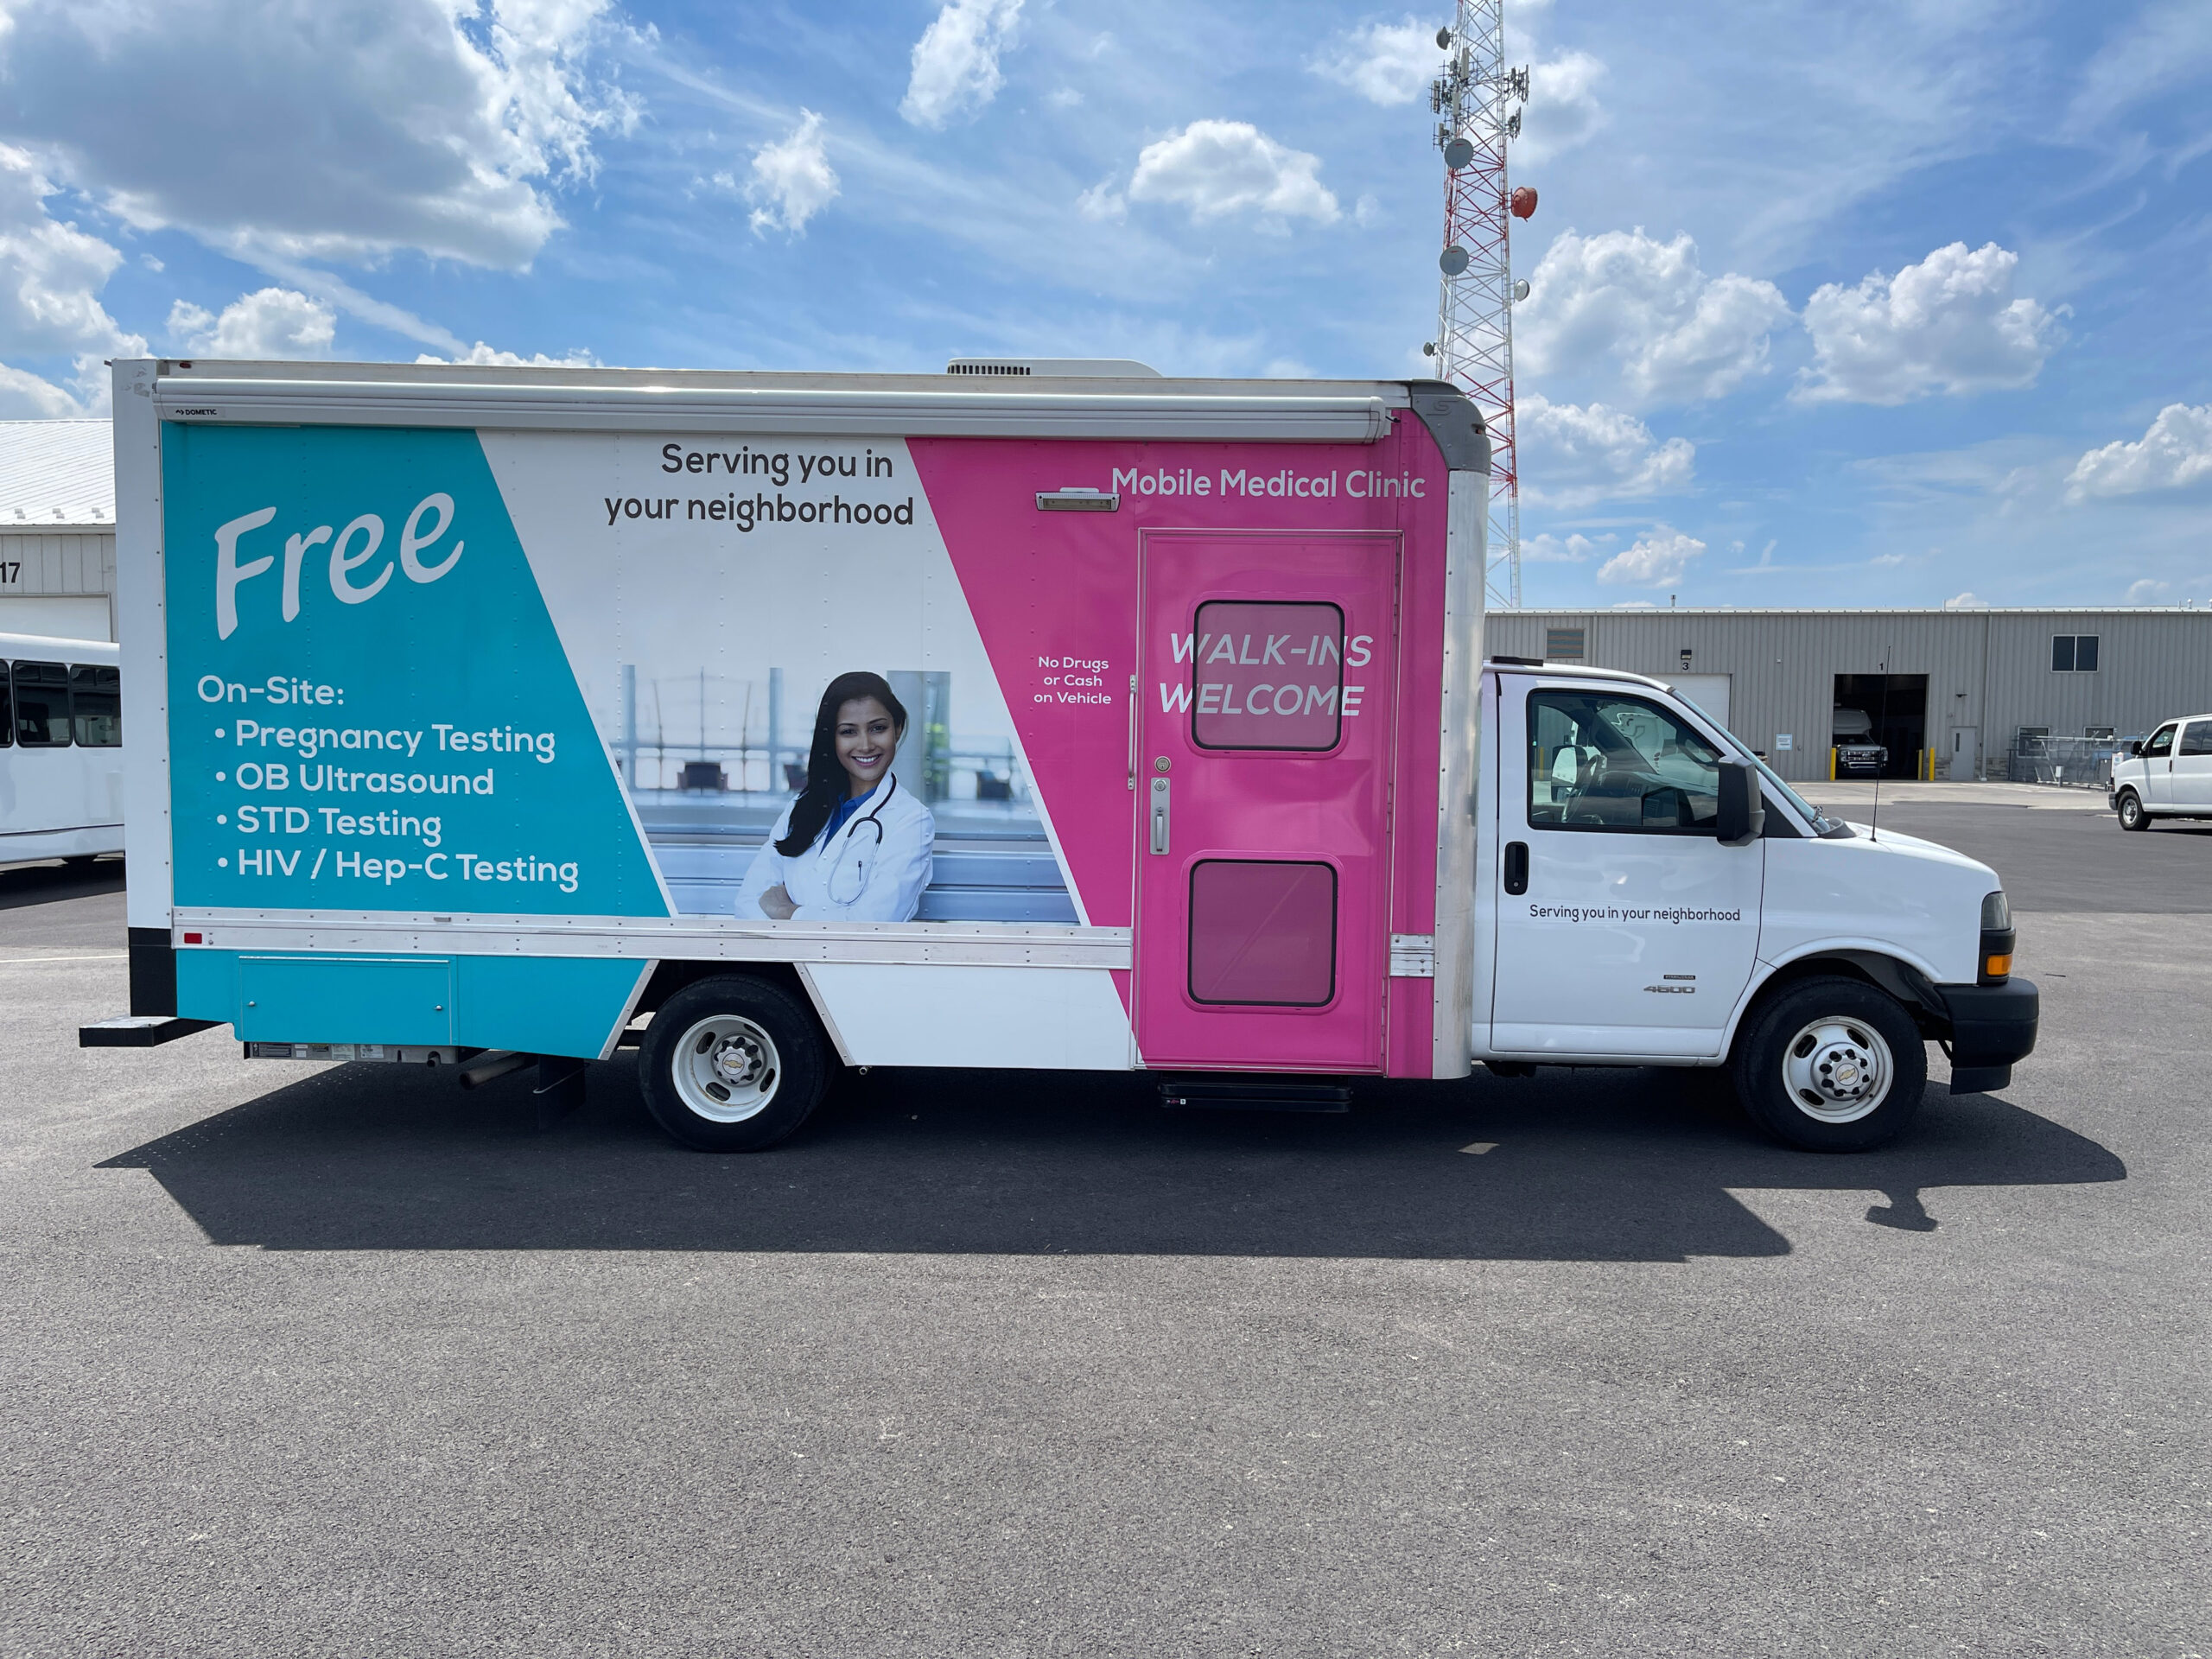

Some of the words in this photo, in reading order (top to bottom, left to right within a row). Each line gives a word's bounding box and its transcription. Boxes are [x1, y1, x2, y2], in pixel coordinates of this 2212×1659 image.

[661, 443, 790, 487] Serving
[797, 454, 856, 484] you
[866, 448, 893, 478] in
[1111, 467, 1212, 498] Mobile
[1220, 469, 1338, 499] Medical
[1345, 469, 1426, 499] Clinic
[604, 497, 680, 526] your
[688, 492, 913, 533] neighborhood
[214, 492, 465, 641] Free
[1038, 656, 1059, 669] No
[1062, 656, 1109, 673] Drugs
[1170, 633, 1374, 666] WALK-INS
[1043, 676, 1061, 687] or
[1064, 674, 1103, 687] Cash
[1682, 662, 1689, 671] 3
[1879, 662, 1884, 671] 1
[197, 674, 344, 707] On-Site:
[1033, 693, 1052, 704] on
[1056, 690, 1112, 705] Vehicle
[1160, 683, 1365, 716] WELCOME
[236, 719, 423, 758] Pregnancy
[431, 723, 556, 764] Testing
[235, 762, 289, 791] OB
[299, 764, 494, 796] Ultrasound
[237, 804, 310, 835] STD
[317, 806, 442, 848] Testing
[238, 849, 302, 877] HIV
[311, 849, 327, 880] /
[336, 849, 448, 887] Hep-C
[455, 852, 579, 893] Testing
[1529, 904, 1580, 923] Serving
[1581, 908, 1605, 921] you
[1607, 906, 1619, 919] in
[1621, 909, 1651, 923] your
[1653, 907, 1741, 925] neighborhood
